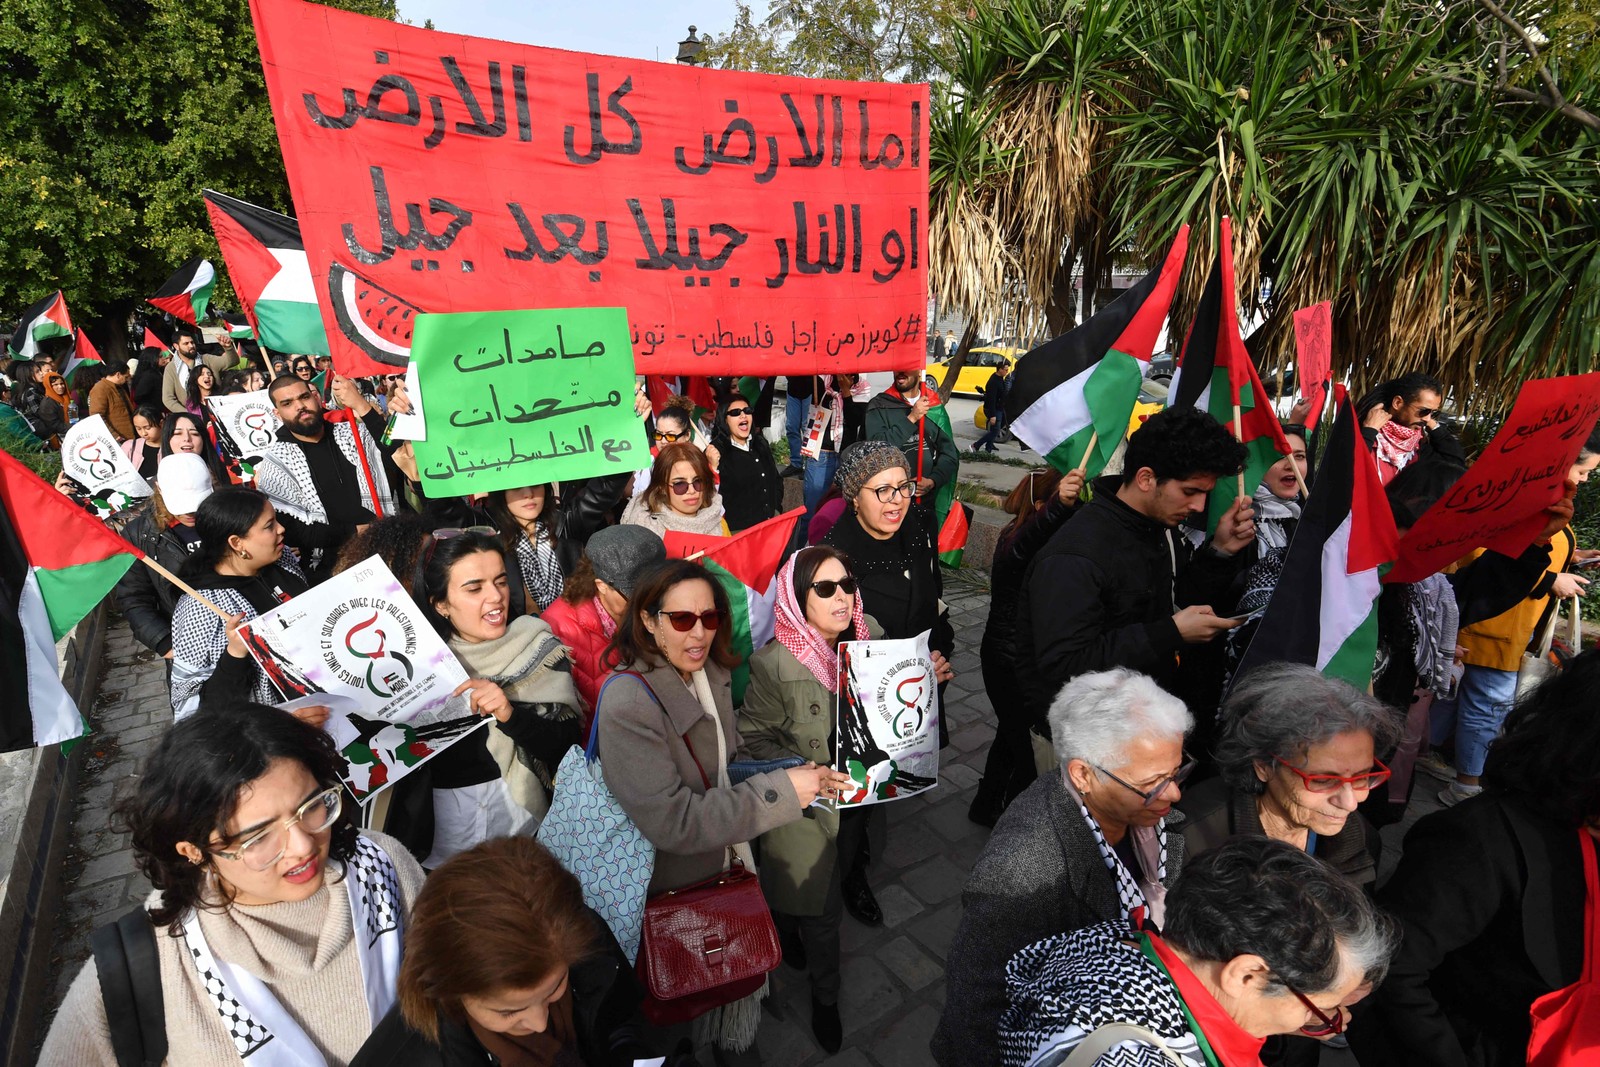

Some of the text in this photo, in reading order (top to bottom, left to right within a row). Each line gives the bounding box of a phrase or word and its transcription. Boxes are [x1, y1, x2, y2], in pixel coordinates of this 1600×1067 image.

[302, 50, 921, 184] اما الارض كل الارض
[341, 165, 918, 289] او النار جيلا بعد جيل
[453, 324, 606, 373] صامدات
[630, 323, 665, 356] تون
[691, 319, 775, 357] فلسطين
[783, 319, 818, 356] اجل
[601, 438, 633, 463] مع
[350, 597, 369, 610] AVEC
[371, 597, 386, 610] LES
[321, 602, 350, 637] SOLIDAIRES
[386, 603, 418, 656] PALESTINIENNES
[320, 639, 333, 649] ET
[323, 651, 342, 673] UNIES
[886, 658, 917, 678] SOLIDAIRES
[338, 669, 365, 689] TOUTES
[389, 677, 409, 696] MARS
